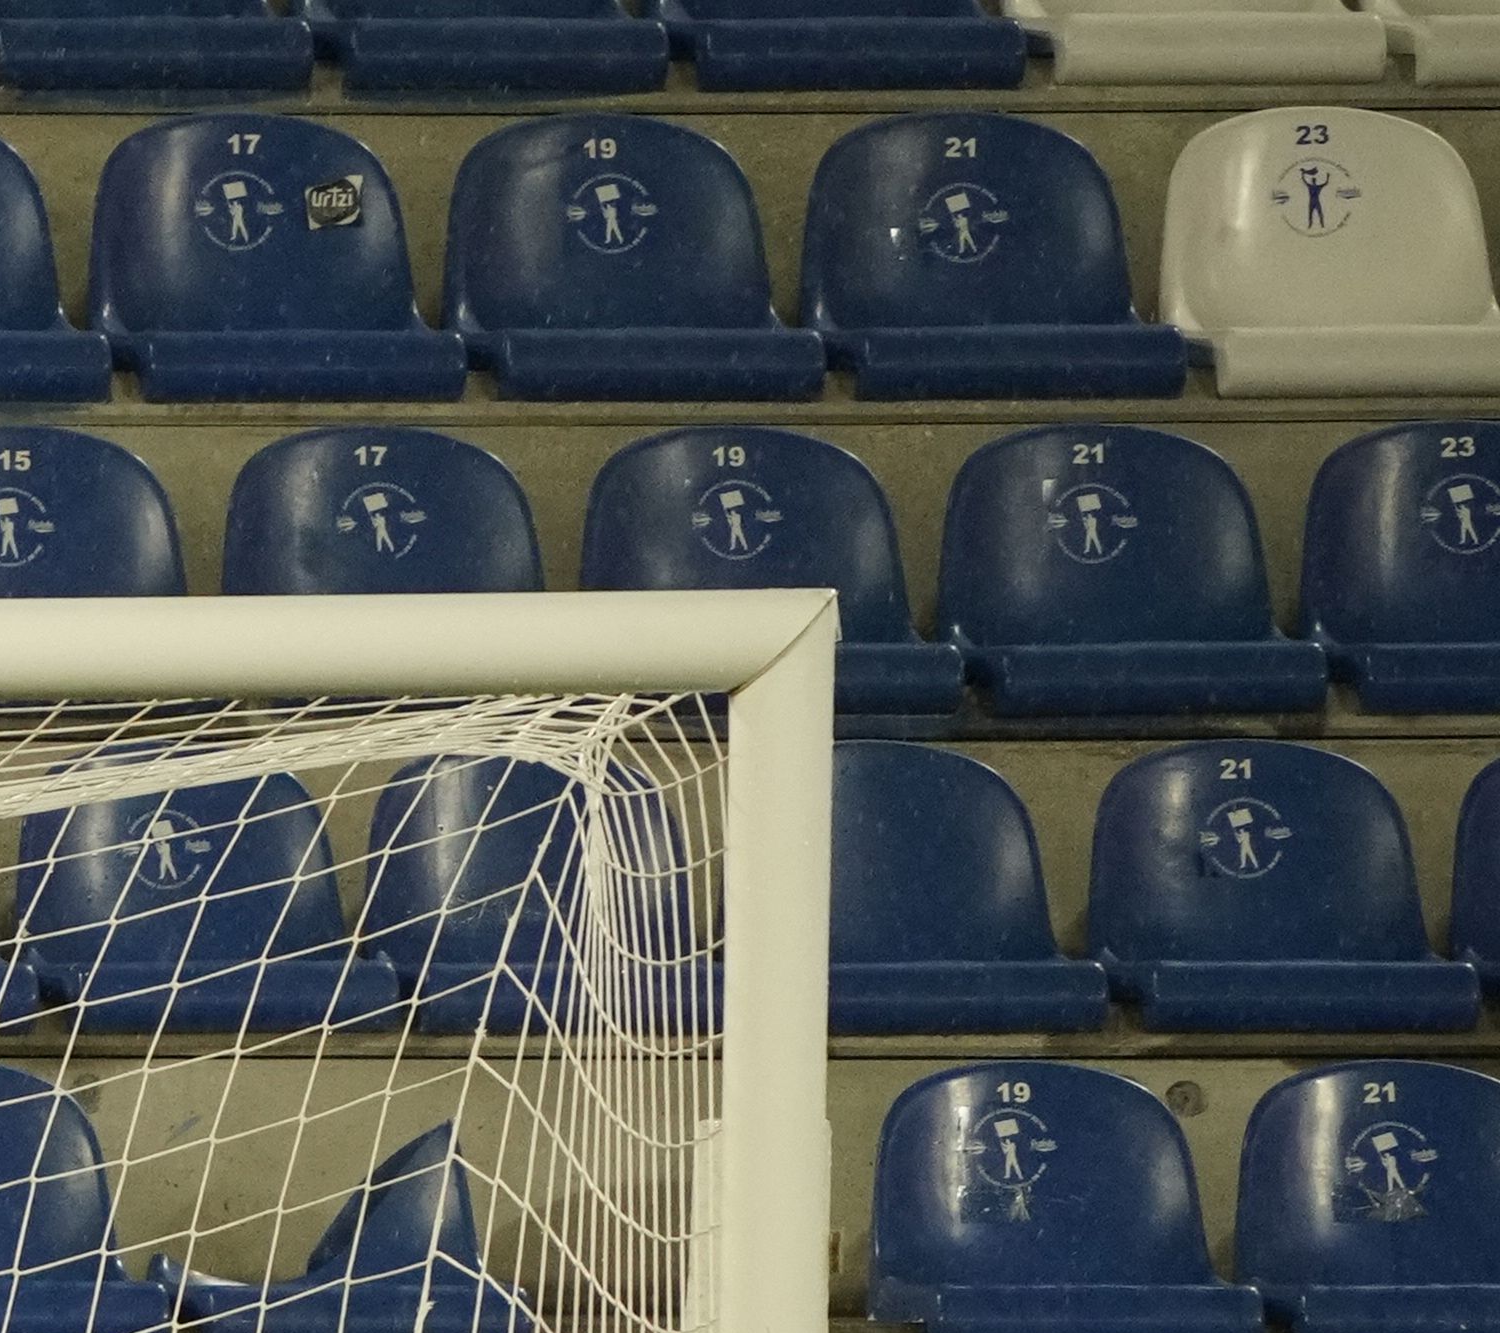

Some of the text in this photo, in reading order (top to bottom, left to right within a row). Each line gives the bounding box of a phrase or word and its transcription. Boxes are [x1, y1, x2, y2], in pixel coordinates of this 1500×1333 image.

[227, 133, 261, 155] 17
[1295, 124, 1330, 146] 23
[583, 138, 617, 159] 19
[945, 136, 976, 158] 21
[354, 445, 388, 466] 17
[712, 446, 746, 467] 19
[1072, 443, 1104, 465] 21
[1440, 436, 1475, 458] 23
[1220, 758, 1252, 780] 21
[996, 1082, 1031, 1103] 19
[1363, 1081, 1396, 1104] 21
